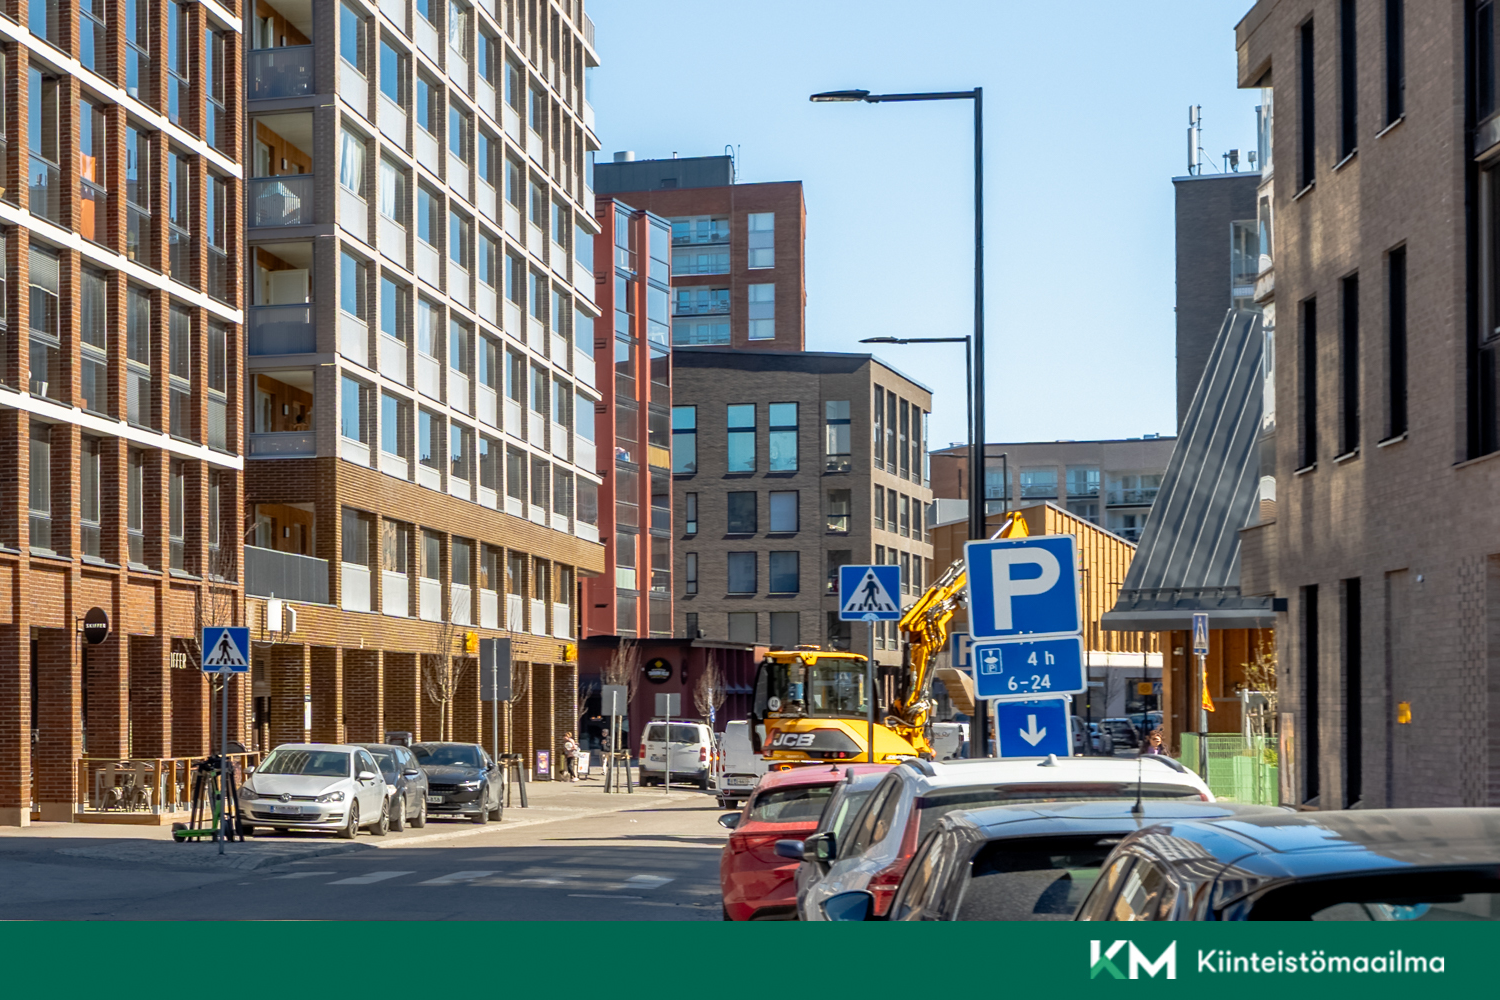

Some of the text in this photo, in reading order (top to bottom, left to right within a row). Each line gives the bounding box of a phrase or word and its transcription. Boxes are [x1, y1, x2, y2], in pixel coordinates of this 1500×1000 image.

[991, 547, 1060, 631] P
[170, 652, 187, 669] IFFER
[1027, 651, 1055, 666] 4 h
[1007, 674, 1051, 690] 6-24
[773, 733, 816, 747] JCB
